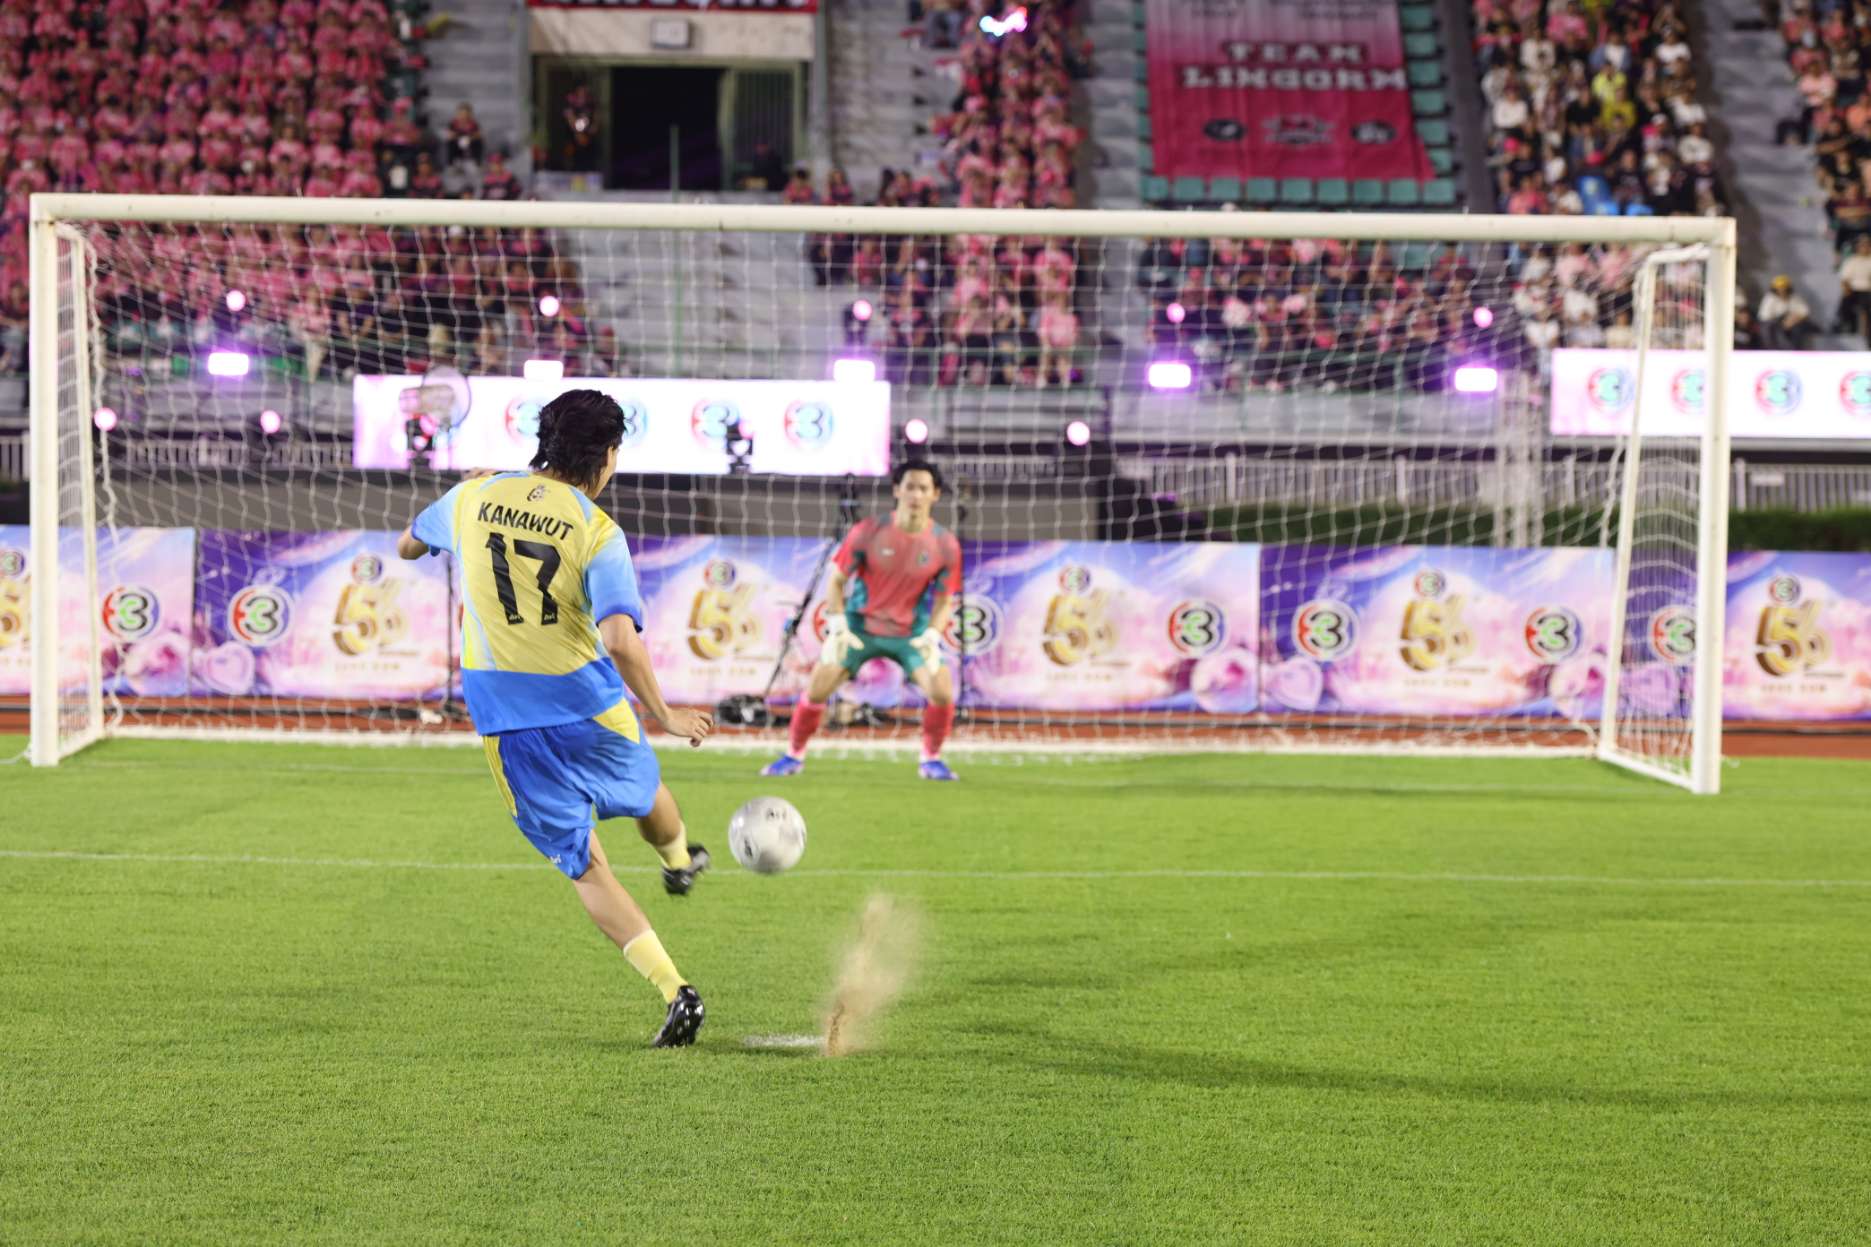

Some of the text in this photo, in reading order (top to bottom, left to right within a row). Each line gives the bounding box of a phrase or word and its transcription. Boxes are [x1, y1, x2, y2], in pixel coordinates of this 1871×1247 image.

[1229, 42, 1362, 63] TEAM
[477, 501, 574, 541] KANAWUT
[485, 531, 561, 626] 17
